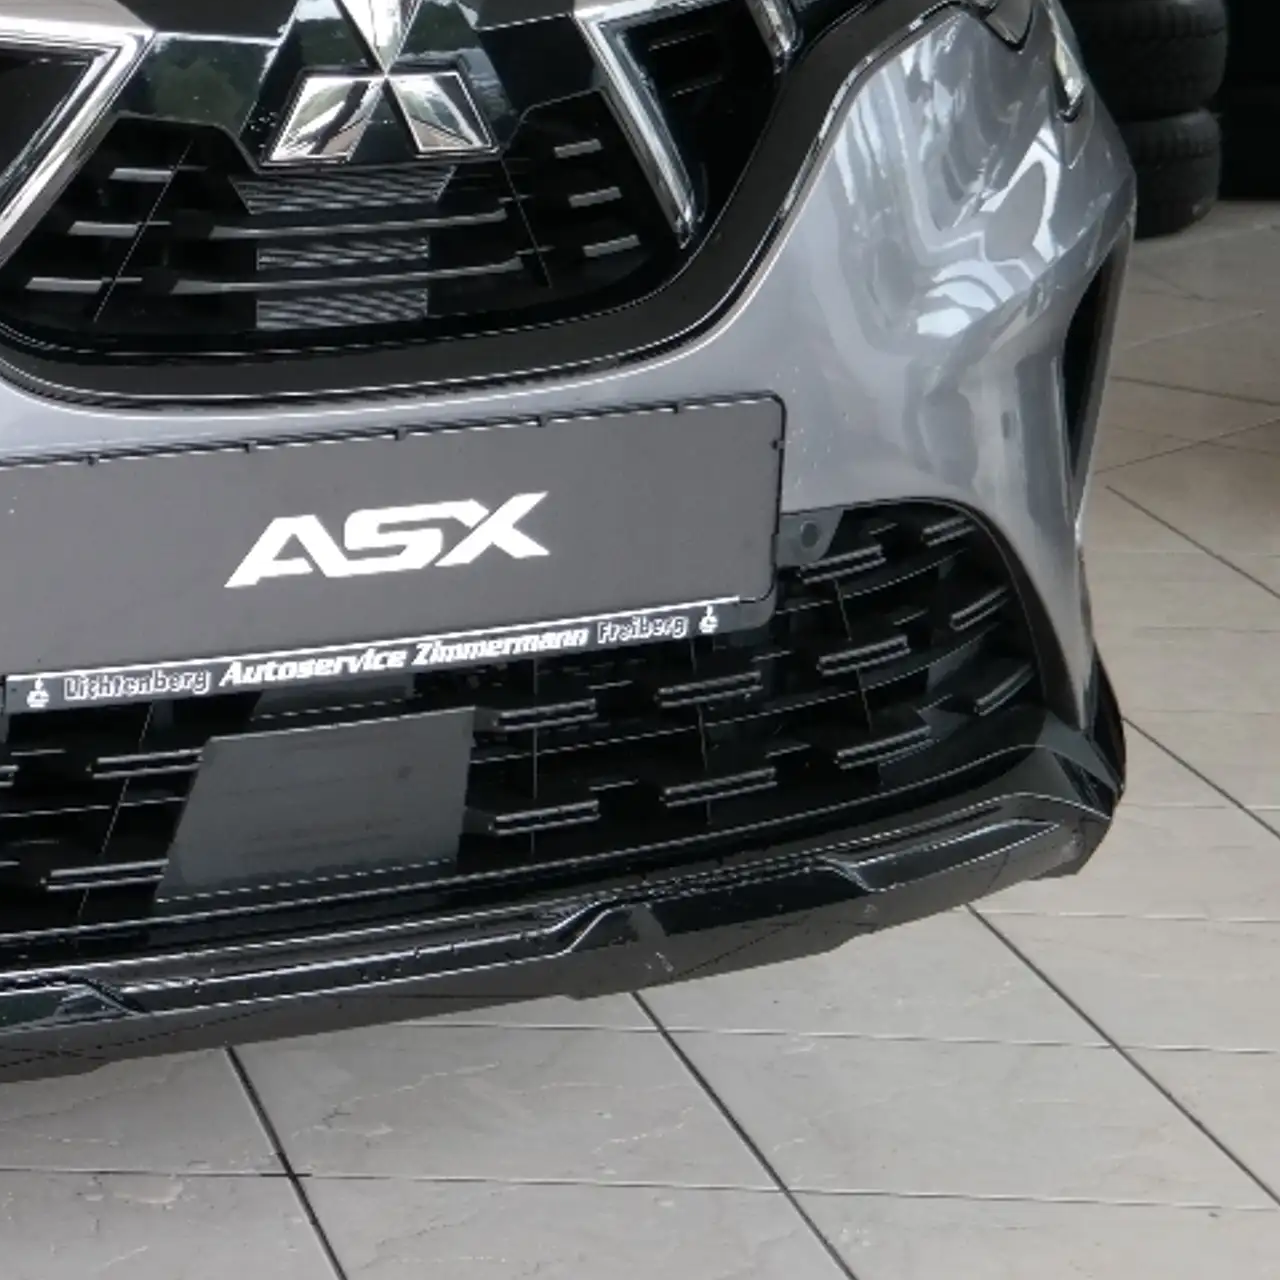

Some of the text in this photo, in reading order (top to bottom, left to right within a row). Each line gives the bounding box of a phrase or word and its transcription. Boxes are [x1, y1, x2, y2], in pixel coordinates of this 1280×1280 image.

[224, 491, 550, 588] ASX
[63, 616, 689, 700] Lichtenberg Autoservice Zimmermann Freiberg
